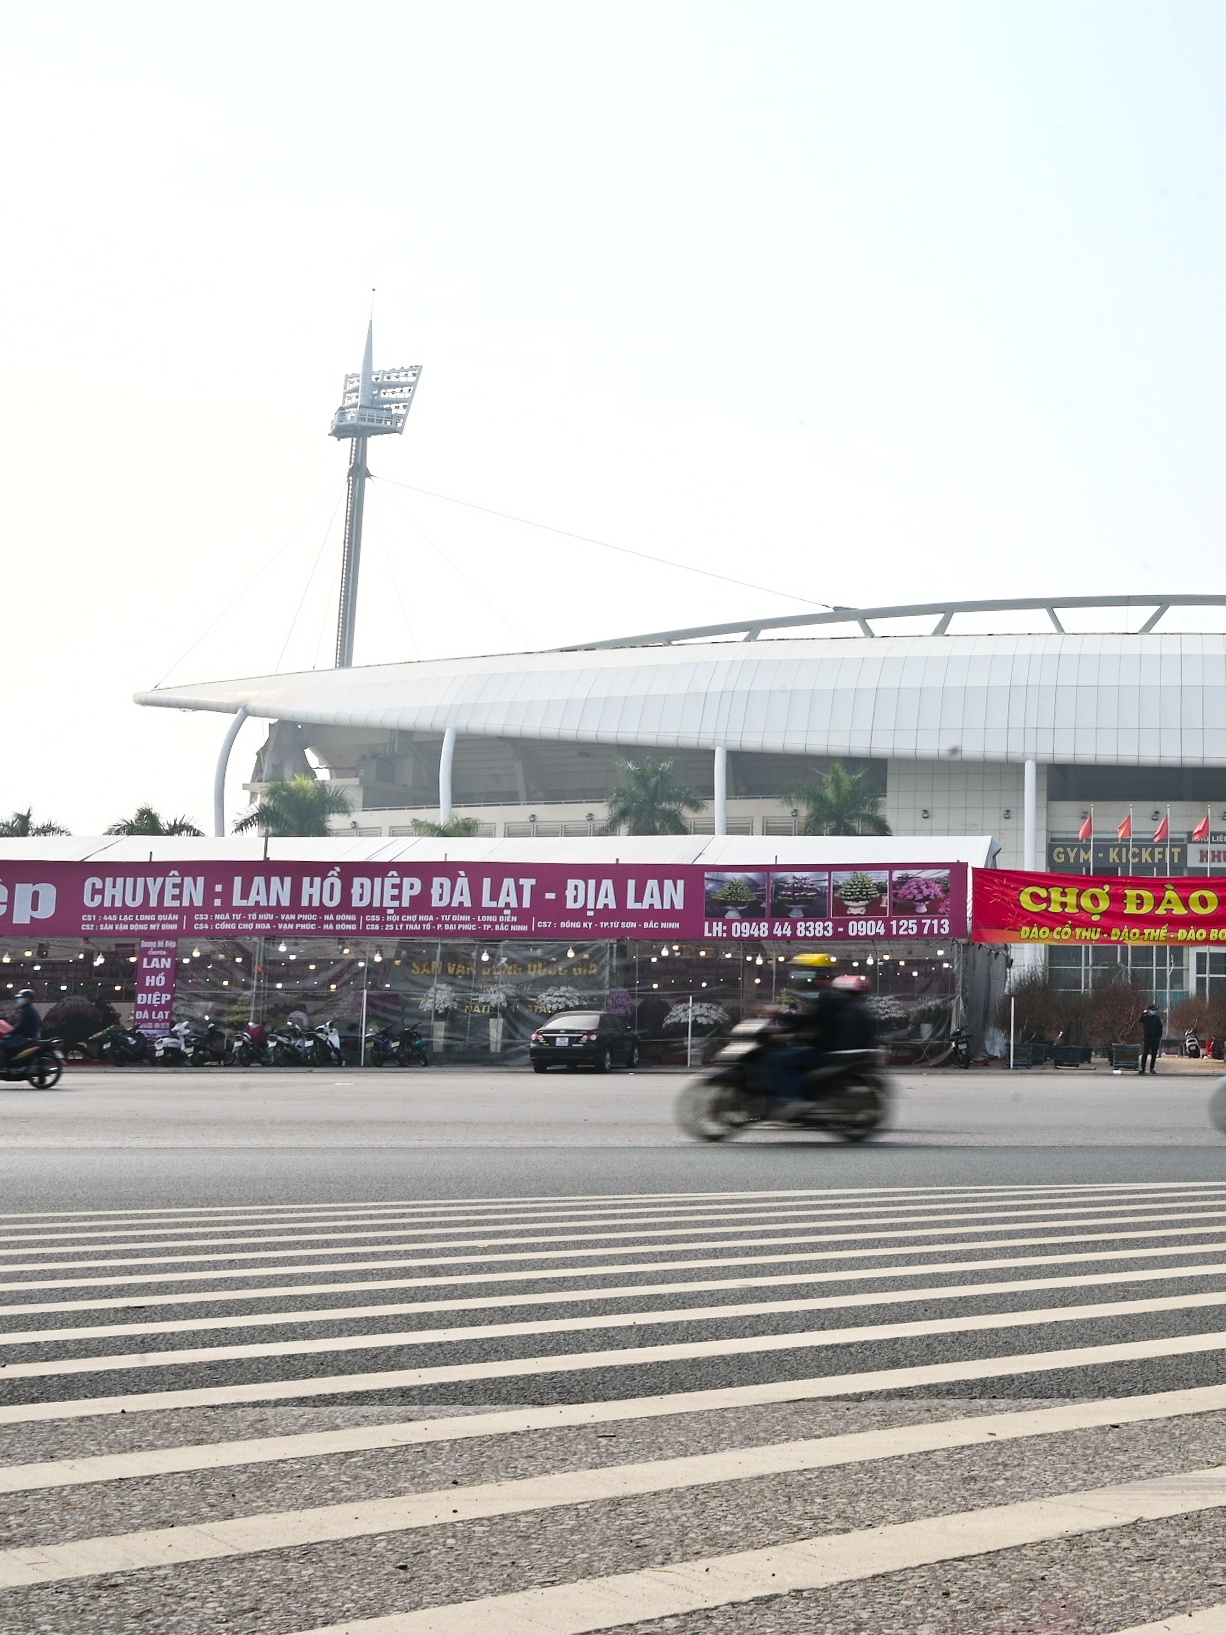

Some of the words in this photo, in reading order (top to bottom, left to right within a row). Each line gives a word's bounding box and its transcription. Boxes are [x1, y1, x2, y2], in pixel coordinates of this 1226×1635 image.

[1053, 847, 1092, 863] GYM
[1109, 847, 1181, 864] KICKFIT
[83, 870, 205, 908] CHUYÊN
[232, 876, 292, 907] LAN
[301, 866, 342, 908] HỒ
[351, 870, 422, 914] ĐIỆP
[431, 870, 472, 908] ĐÀ
[482, 877, 536, 915] LẠT
[566, 878, 616, 916] ĐỊA
[626, 879, 684, 910] LAN
[1019, 884, 1111, 922] CHỢ
[1123, 884, 1219, 916] ĐÀO
[704, 922, 727, 938] LH:
[732, 921, 769, 937] 0948
[772, 922, 792, 937] 44
[796, 921, 834, 937] 8383
[848, 920, 885, 936] 0904
[890, 920, 918, 936] 125
[922, 919, 950, 935] 713
[1020, 924, 1050, 940] ĐÀO
[1052, 920, 1072, 940] CỔ
[1075, 927, 1100, 943] THỤ
[1110, 925, 1140, 941] ĐÀO
[1143, 924, 1168, 941] THẾ
[1178, 926, 1206, 941] ĐÀO
[142, 958, 171, 969] LAN
[137, 991, 171, 1007] ĐIỆP
[136, 1010, 149, 1019] ĐÀ
[152, 1011, 170, 1021] LẠT
